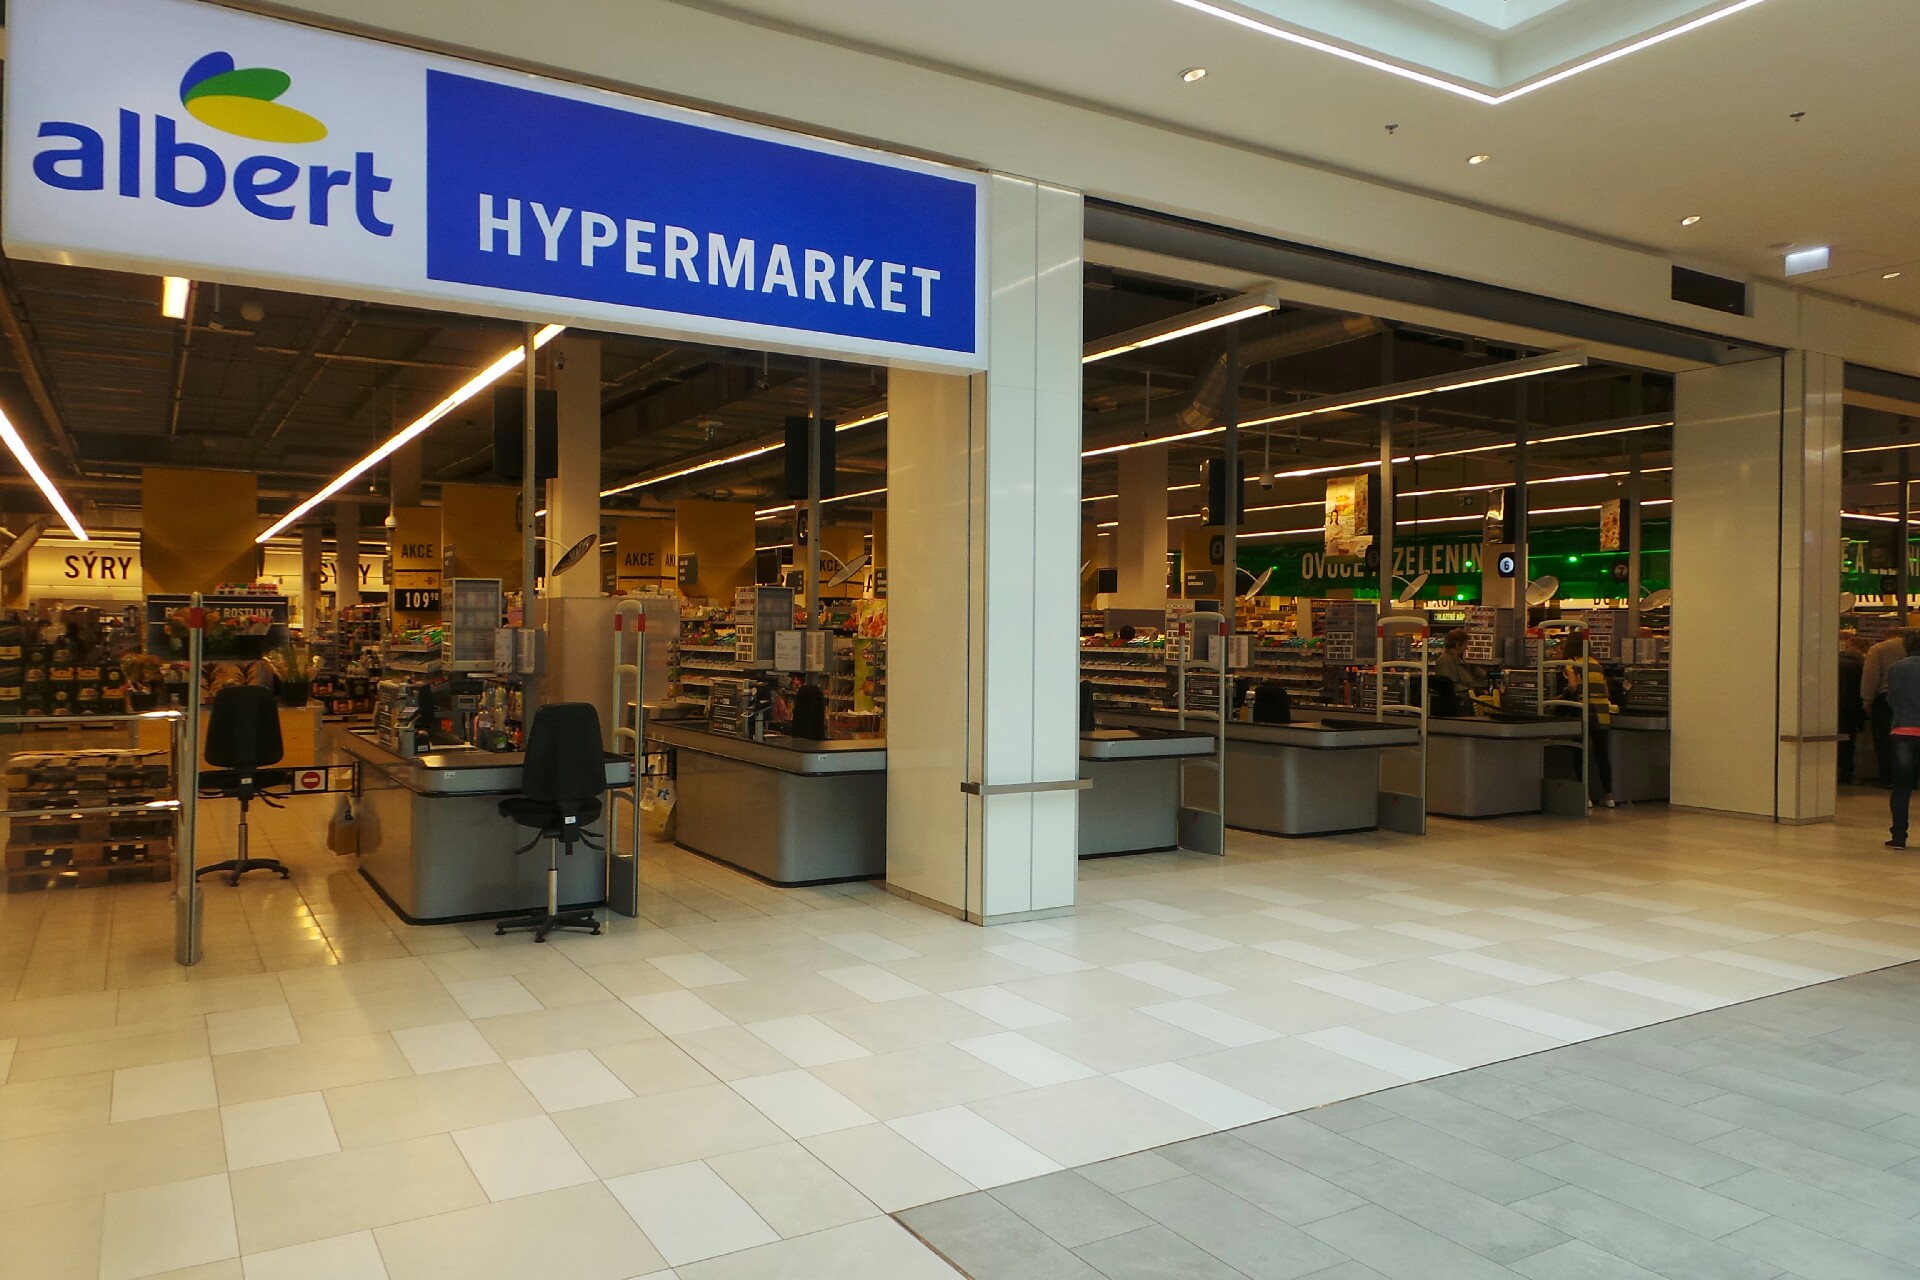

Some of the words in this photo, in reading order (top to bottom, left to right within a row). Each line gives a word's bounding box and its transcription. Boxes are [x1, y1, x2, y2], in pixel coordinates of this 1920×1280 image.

[32, 107, 394, 238] albert
[477, 193, 943, 318] HYPERMARKET
[64, 551, 133, 580] SÝRY
[401, 543, 434, 560] AKCE
[624, 552, 655, 567] AKCE
[1392, 542, 1483, 576] ZELENIN
[223, 607, 274, 619] ROSTLINY
